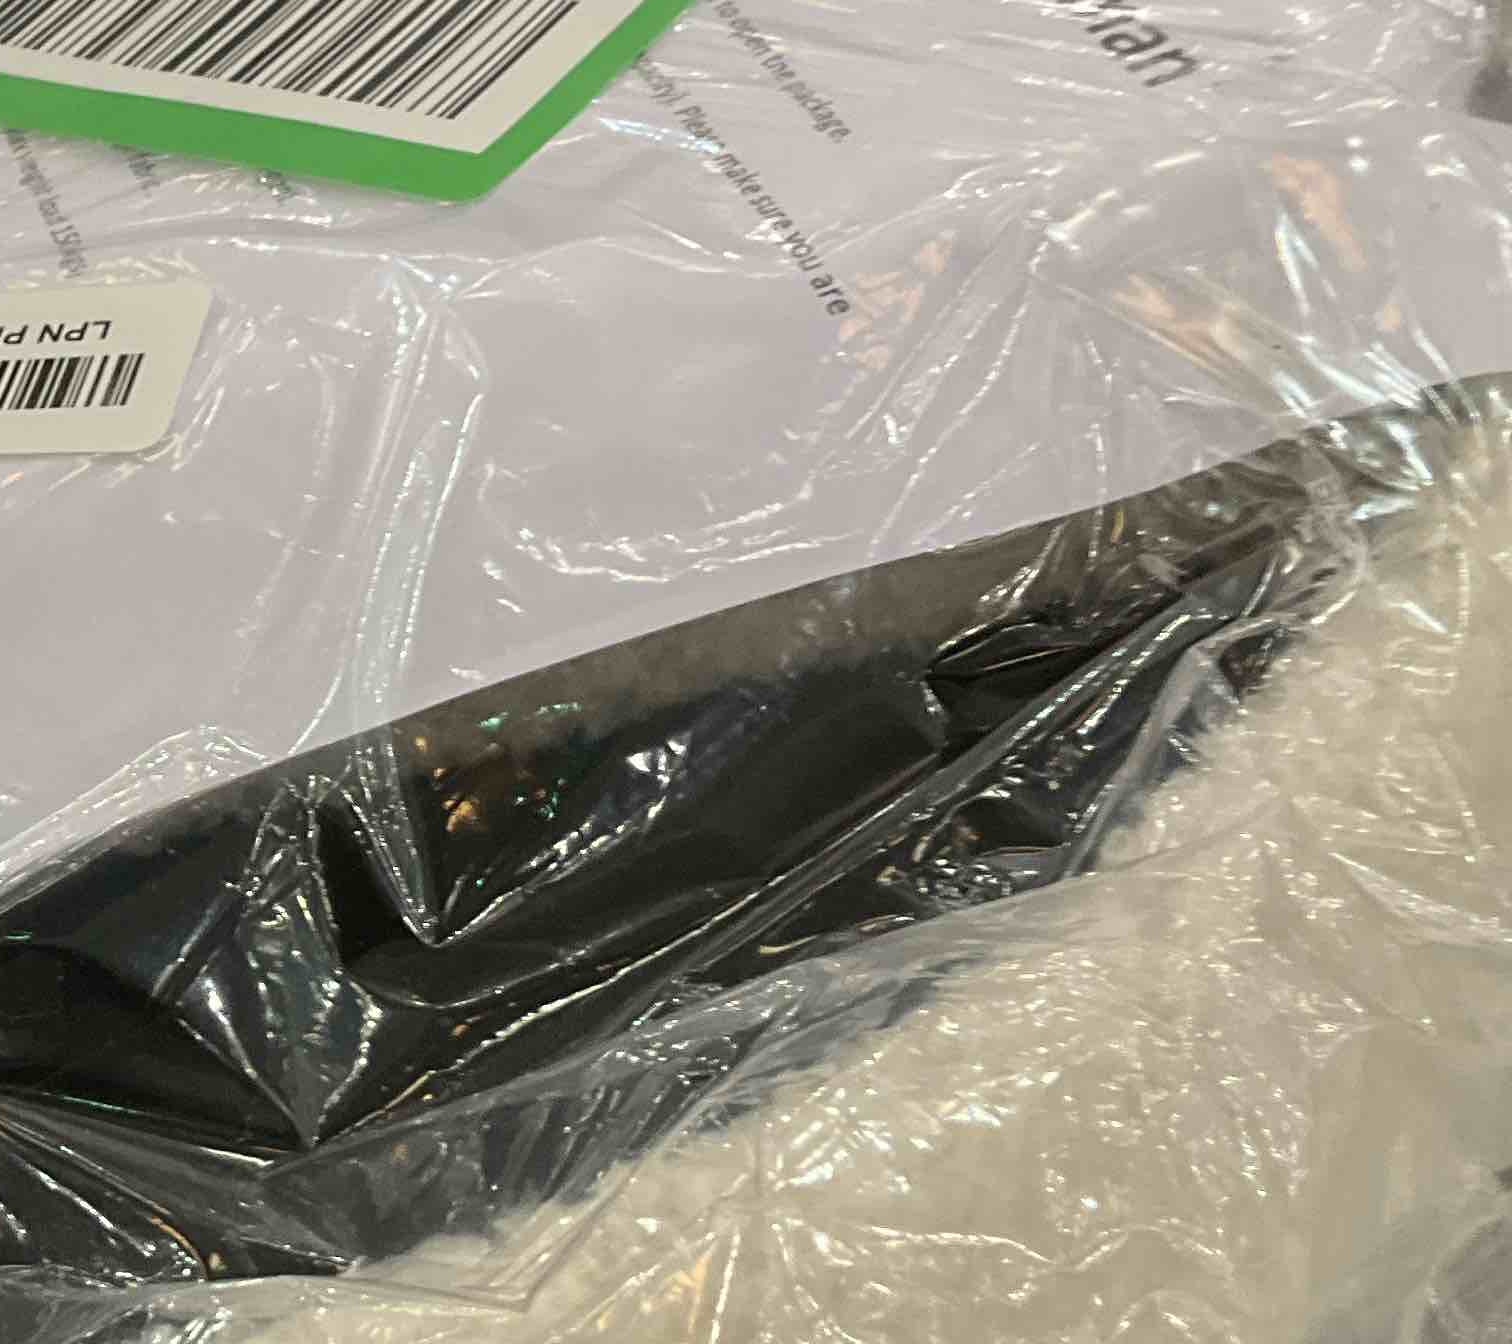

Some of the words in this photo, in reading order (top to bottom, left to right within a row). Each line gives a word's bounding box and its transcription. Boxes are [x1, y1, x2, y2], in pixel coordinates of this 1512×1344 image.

[716, 153, 763, 196] make
[749, 194, 794, 230] sure
[782, 231, 824, 273] you
[809, 272, 851, 316] are
[37, 319, 114, 344] LPN
